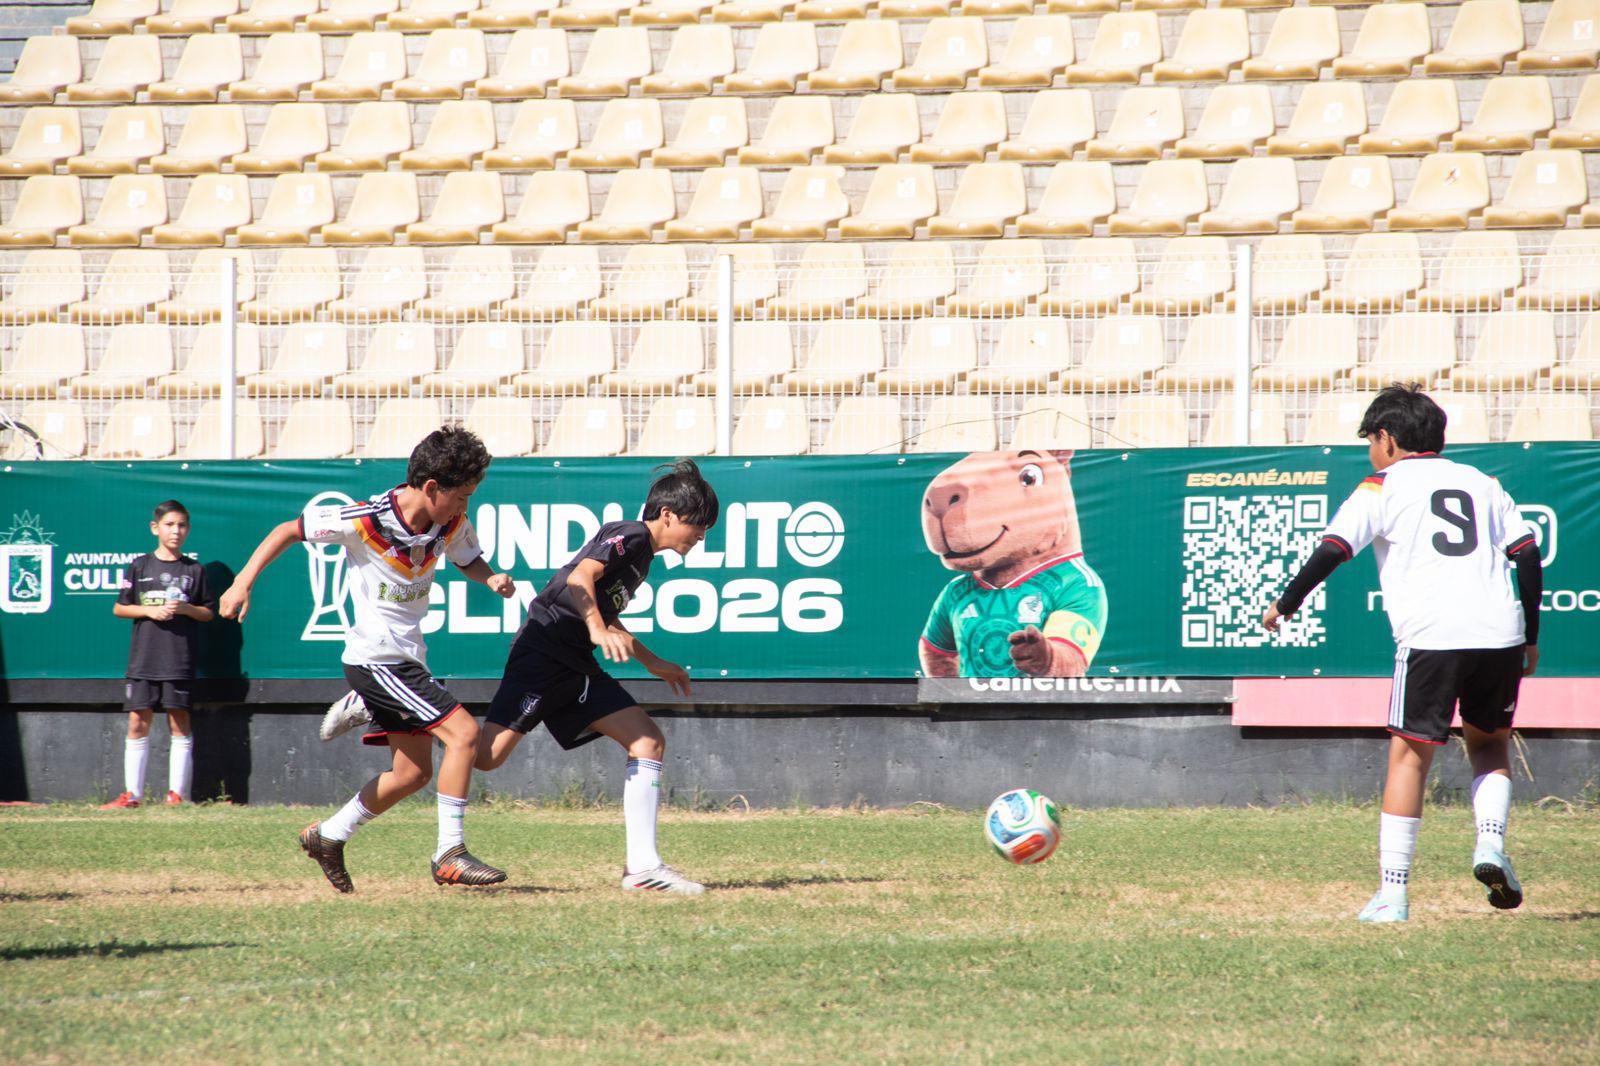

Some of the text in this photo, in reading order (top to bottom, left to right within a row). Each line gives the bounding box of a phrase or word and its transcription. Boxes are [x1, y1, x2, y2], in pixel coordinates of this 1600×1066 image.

[1186, 468, 1328, 487] ESCANÉAME
[1431, 489, 1478, 557] 9
[63, 568, 126, 590] CULI
